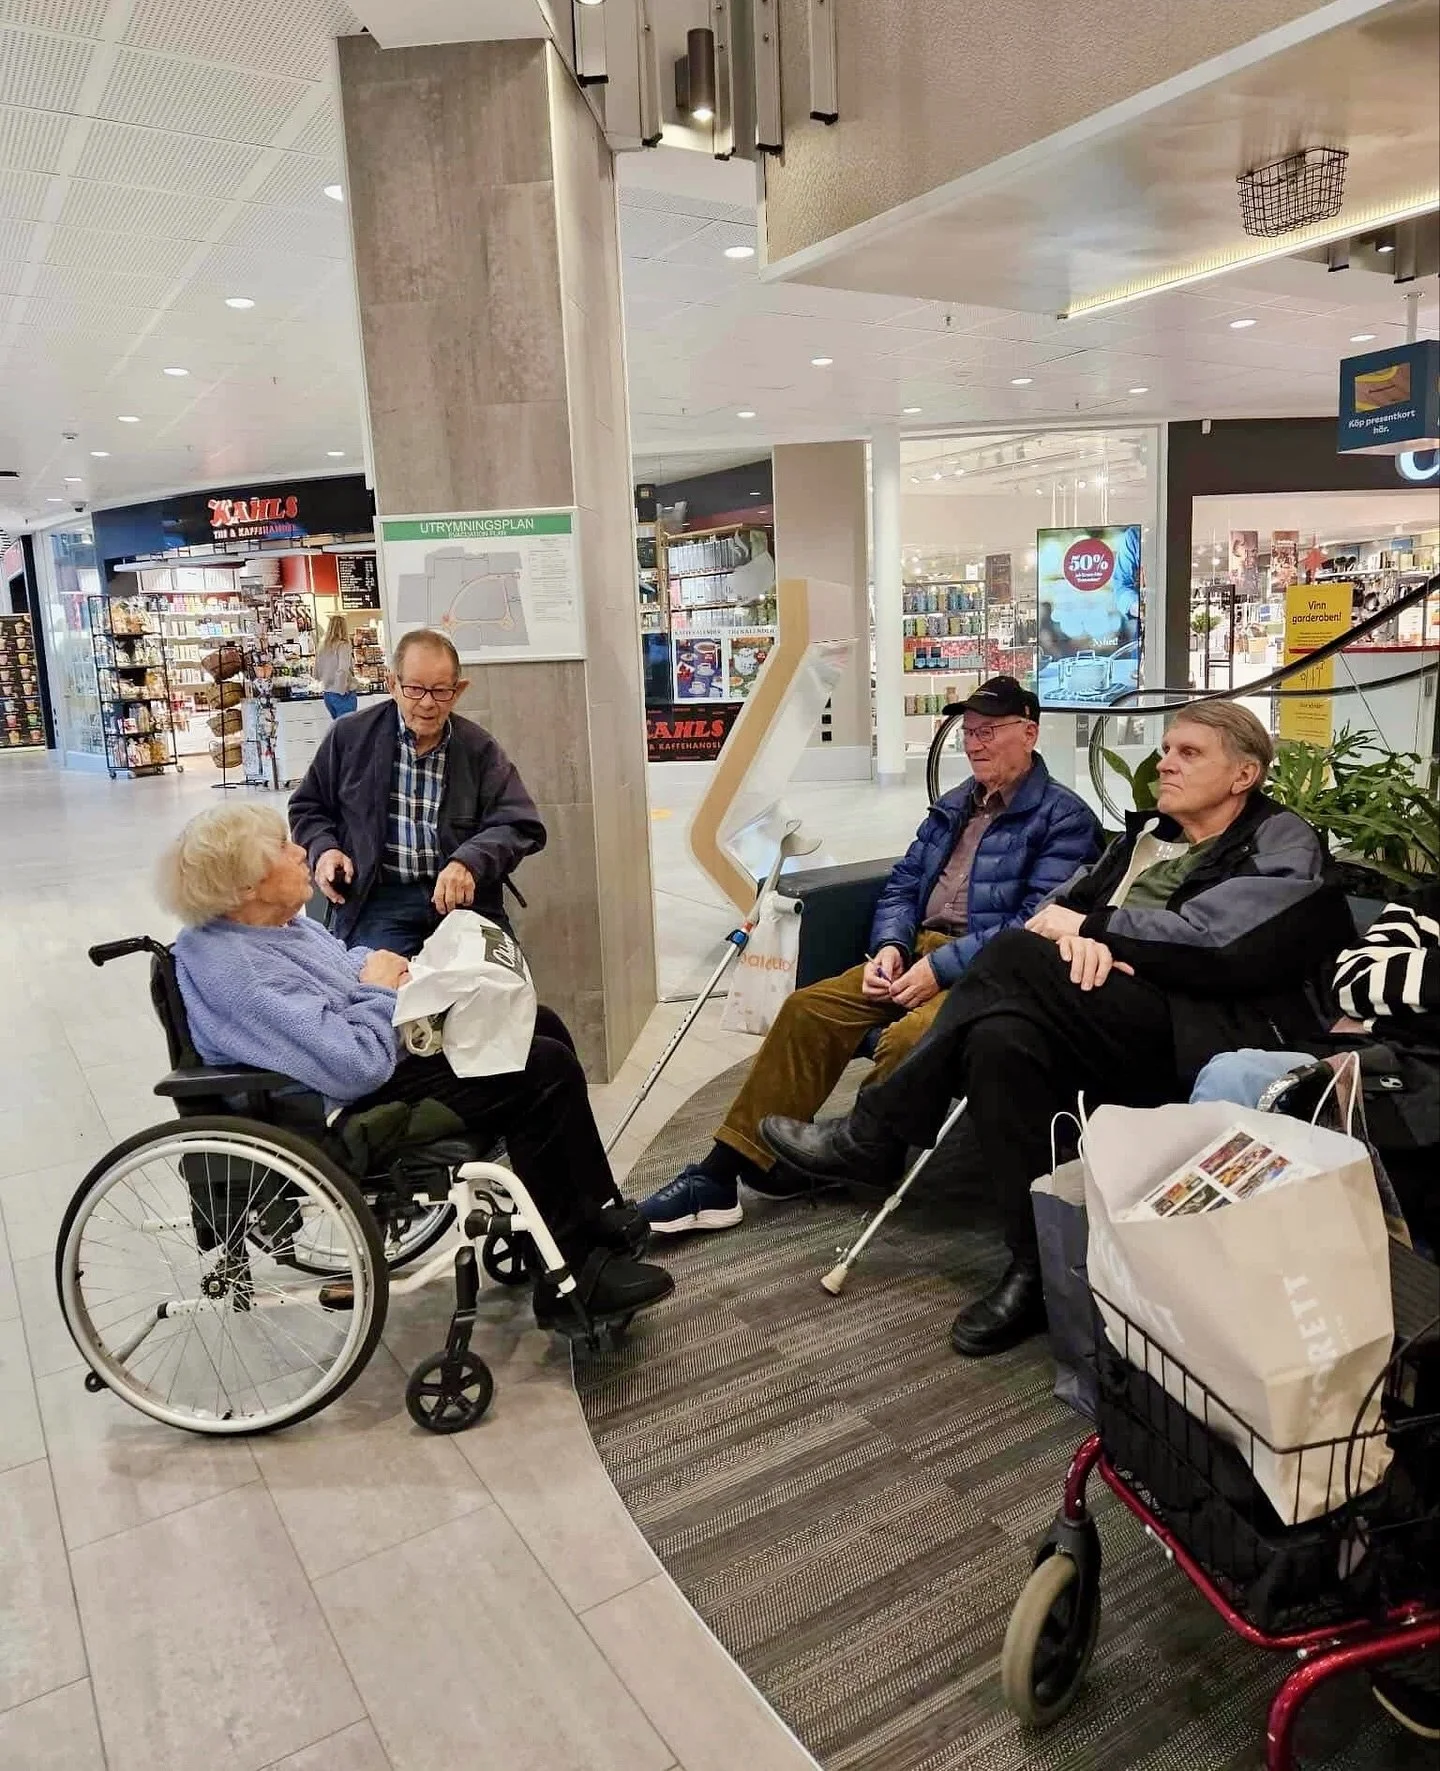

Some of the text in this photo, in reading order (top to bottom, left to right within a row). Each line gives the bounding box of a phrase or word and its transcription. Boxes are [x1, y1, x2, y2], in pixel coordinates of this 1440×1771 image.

[1348, 411, 1416, 429] Köp presentkort
[208, 496, 298, 526] KAHLS
[420, 518, 534, 534] UTRYMNINGSPLAN
[1069, 553, 1109, 571] 50%
[1307, 600, 1327, 610] Vinn
[1292, 611, 1342, 625] garderoben!
